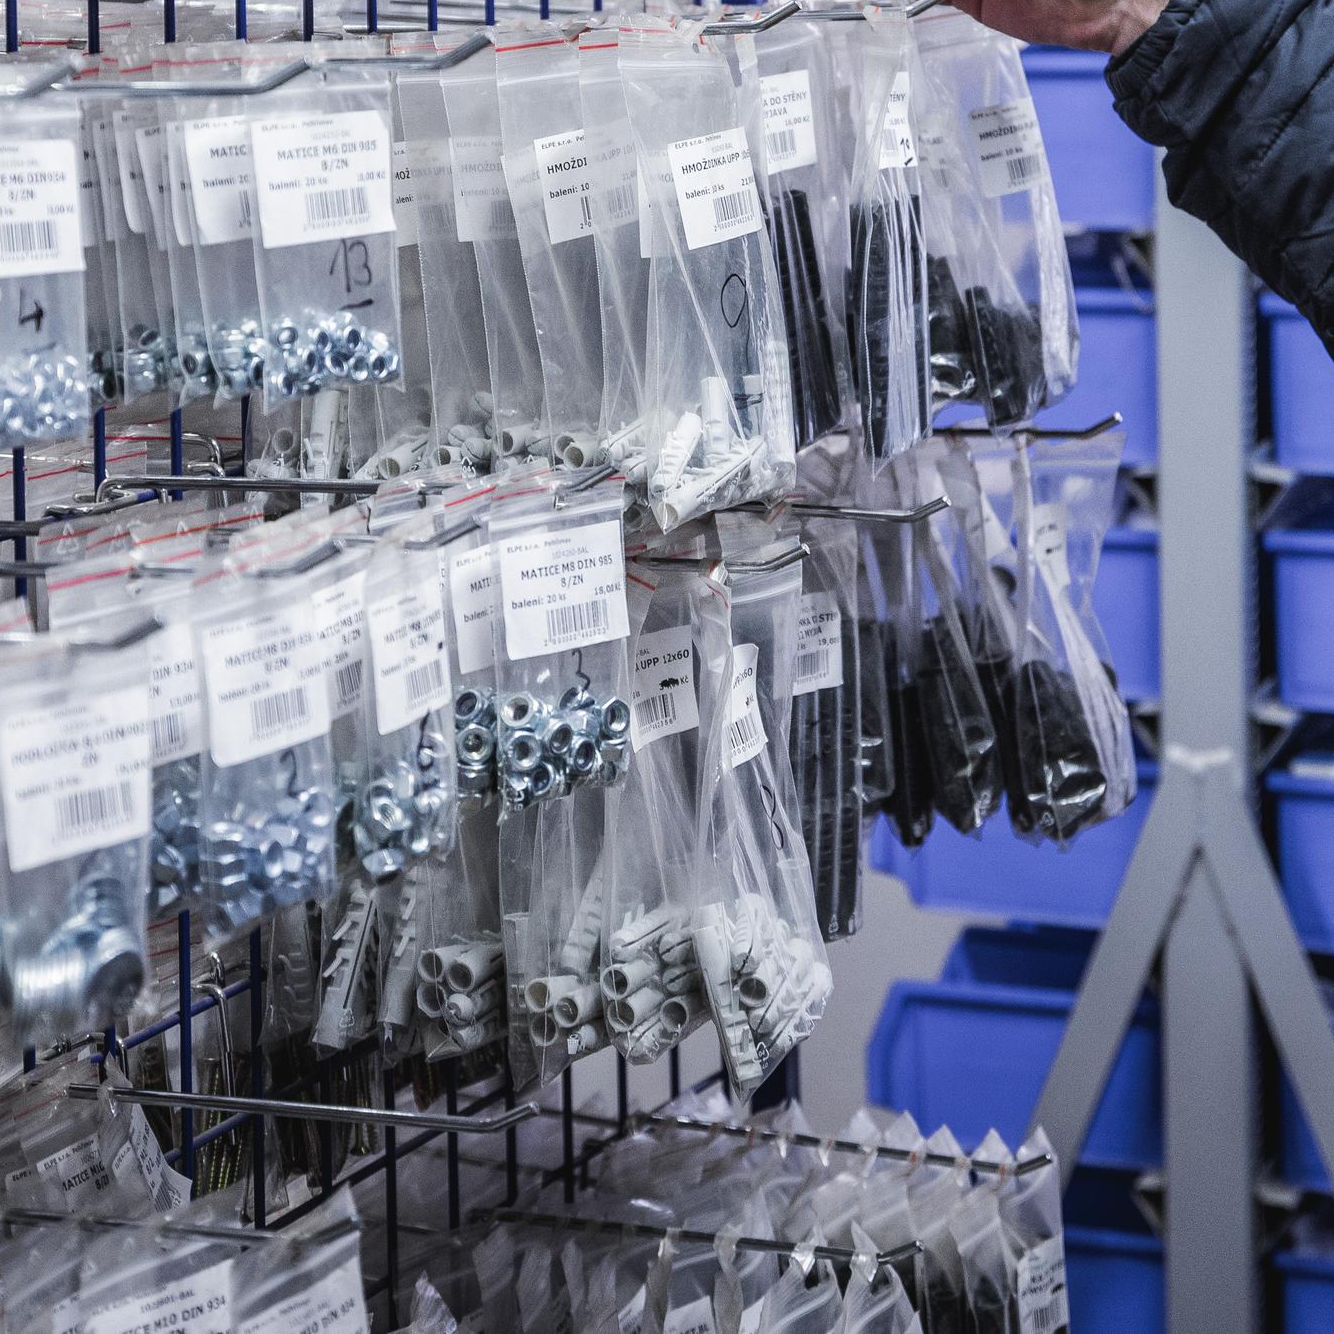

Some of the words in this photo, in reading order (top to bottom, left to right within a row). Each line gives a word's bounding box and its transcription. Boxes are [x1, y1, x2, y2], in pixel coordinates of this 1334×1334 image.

[769, 97, 782, 106] DO
[783, 91, 808, 104] STĚNY
[276, 145, 319, 160] MATICE
[322, 143, 338, 156] M6
[340, 141, 357, 154] DIN
[359, 139, 378, 152] 985
[541, 141, 556, 150] ELPE
[547, 157, 589, 176] HMOŽDI
[681, 156, 727, 175] HMOŽDINKA
[727, 152, 741, 165] UPP
[549, 184, 579, 199] balení:
[580, 182, 591, 192] 10
[685, 188, 711, 200] balení:
[329, 239, 374, 294] 13
[520, 564, 560, 581] MATICE
[561, 561, 576, 573] M8
[577, 557, 597, 570] DIN
[598, 554, 613, 566] 985
[560, 574, 585, 589] 8/ZN
[593, 583, 614, 596] 18,00
[511, 596, 545, 610] balení:
[546, 593, 557, 604] 20
[640, 656, 659, 670] UPP
[662, 648, 690, 665] 12x60
[679, 674, 689, 685] Kč
[43, 1158, 58, 1171] ELPE
[181, 1304, 206, 1323] DIN
[205, 1294, 227, 1314] 934
